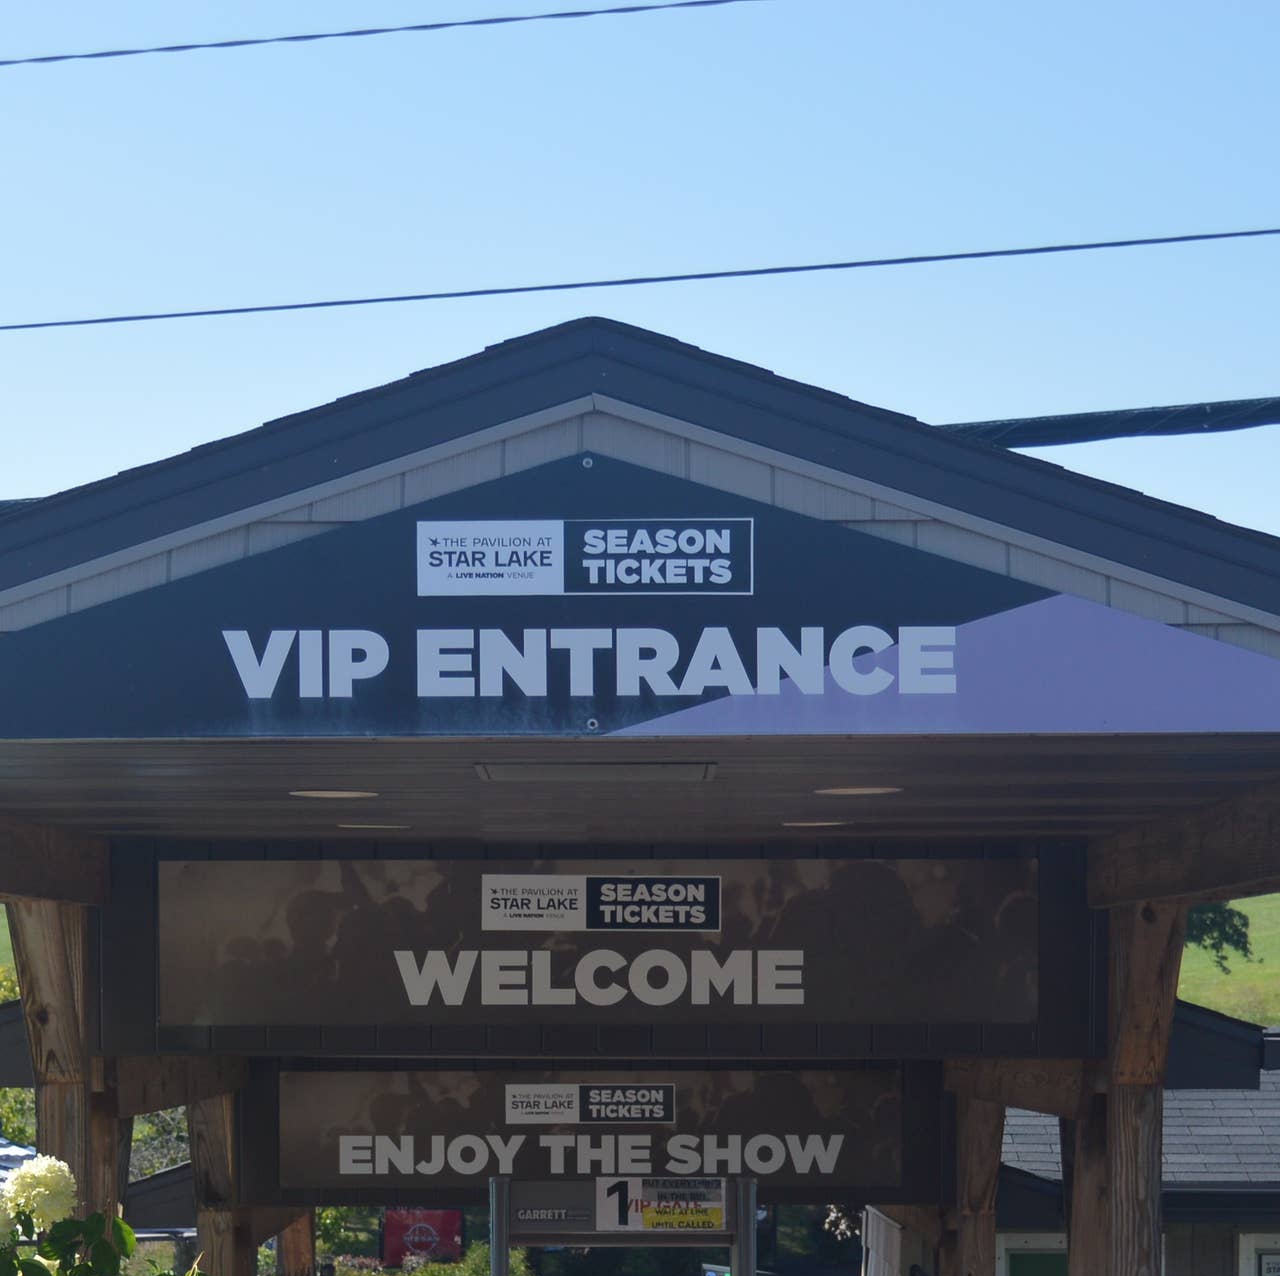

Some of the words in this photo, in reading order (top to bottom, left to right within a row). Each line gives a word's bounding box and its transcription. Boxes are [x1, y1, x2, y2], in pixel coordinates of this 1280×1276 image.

[442, 537, 467, 547] THE
[472, 537, 531, 547] PAVILION
[536, 537, 552, 547] AT
[582, 528, 731, 555] SEASON
[428, 551, 486, 567] STAR
[494, 550, 552, 567] LAKE
[582, 559, 732, 585] TICKETS
[222, 628, 389, 699] VIP
[417, 625, 957, 698] ENTRANCE
[500, 888, 517, 896] THE
[521, 888, 564, 896] PAVILION
[567, 888, 579, 896] AT
[600, 883, 705, 902] SEASON
[490, 898, 531, 910] STAR
[537, 898, 579, 910] LAKE
[600, 905, 706, 924] TICKETS
[393, 949, 805, 1006] WELCOME
[589, 1090, 664, 1103] SEASON
[511, 1100, 542, 1110] STAR
[544, 1100, 574, 1109] LAKE
[589, 1105, 664, 1118] TICKETS
[338, 1134, 526, 1175] ENJOY
[539, 1135, 652, 1175] THE
[664, 1134, 845, 1175] SHOW
[607, 1181, 628, 1225] 1
[627, 1199, 651, 1213] VIP
[518, 1209, 567, 1220] GARRETT
[651, 1221, 677, 1229] UNTIL
[678, 1221, 714, 1229] CALLED
